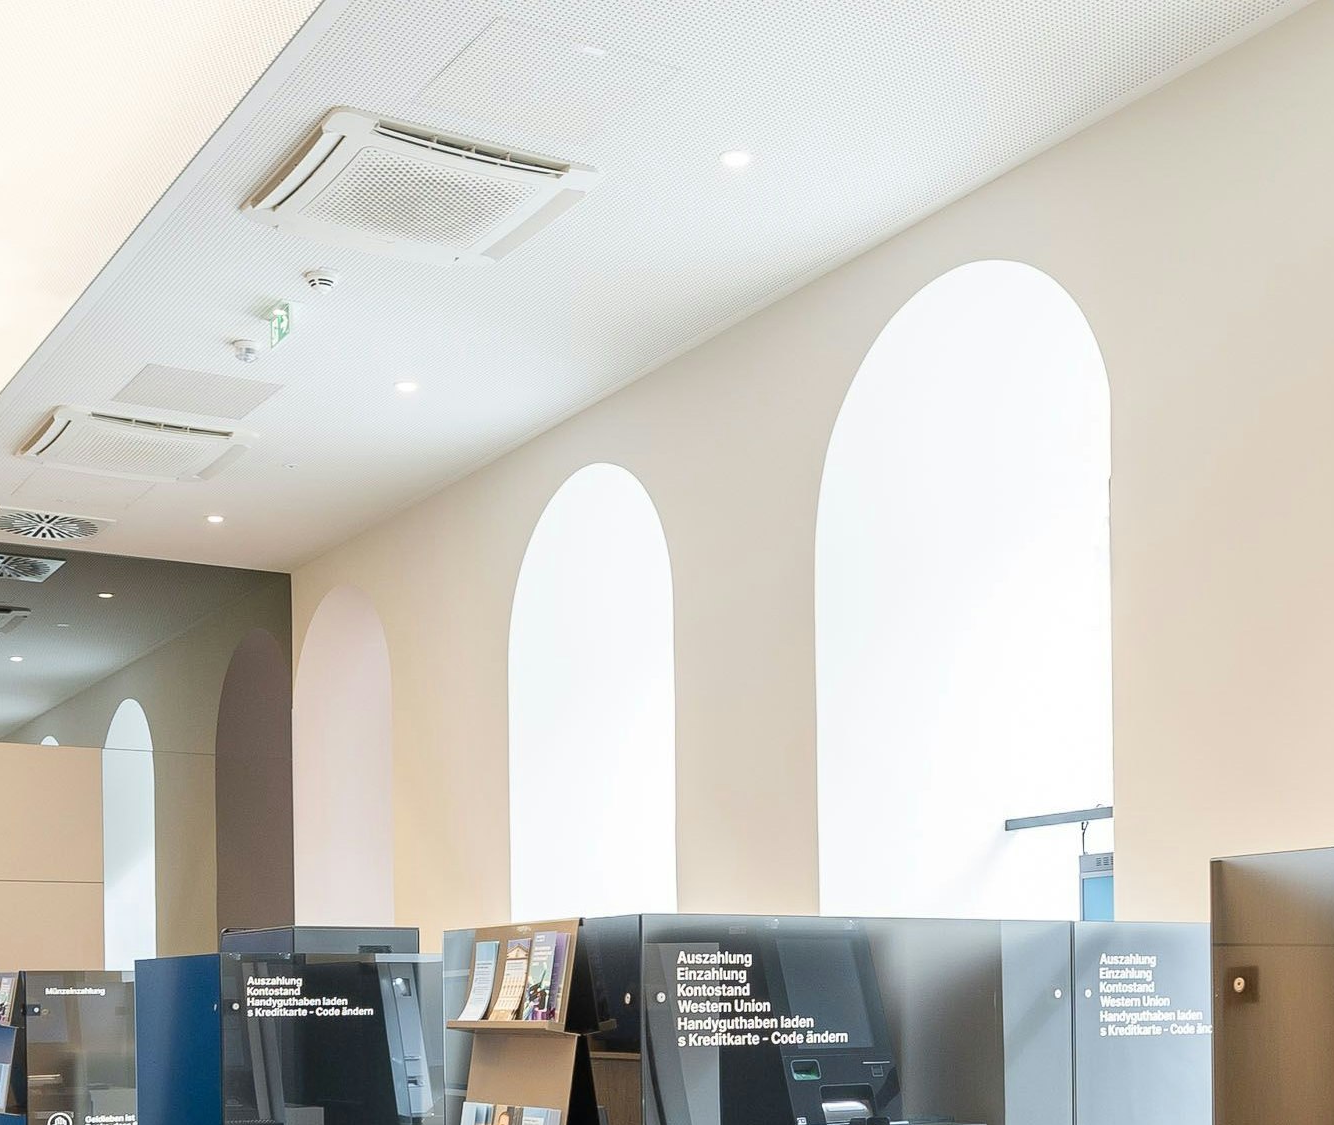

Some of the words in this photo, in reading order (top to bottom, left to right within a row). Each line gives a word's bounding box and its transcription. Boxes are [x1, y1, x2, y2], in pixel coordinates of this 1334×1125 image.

[677, 951, 752, 966] Auszahlung
[1099, 953, 1157, 967] Auszahlung
[677, 967, 747, 983] Einzahlung
[1099, 967, 1153, 981] Einzahlung
[247, 976, 302, 987] Auszahlung
[1099, 981, 1155, 993] Kontostand
[247, 987, 301, 996] Kontostand
[677, 983, 750, 997] Kontostand
[247, 997, 321, 1007] Handyguthaben
[322, 997, 348, 1006] laden
[677, 1000, 732, 1013] Western
[734, 999, 771, 1012] Union
[1100, 996, 1141, 1007] Western
[1142, 995, 1171, 1007] Union
[255, 1007, 307, 1017] Kreditkarte
[316, 1007, 340, 1016] Code
[342, 1007, 374, 1016] ändern
[1099, 1010, 1175, 1024] Handyguthaben
[1177, 1010, 1203, 1021] laden
[677, 1016, 778, 1032] Handyguthaben
[780, 1015, 814, 1028] laden
[1100, 1027, 1107, 1036] s
[1108, 1024, 1162, 1036] Kreditkarte
[1170, 1023, 1195, 1035] Code
[677, 1035, 686, 1047] s
[688, 1032, 760, 1047] Kreditkarte
[771, 1031, 804, 1045] Code
[806, 1031, 848, 1044] ändern
